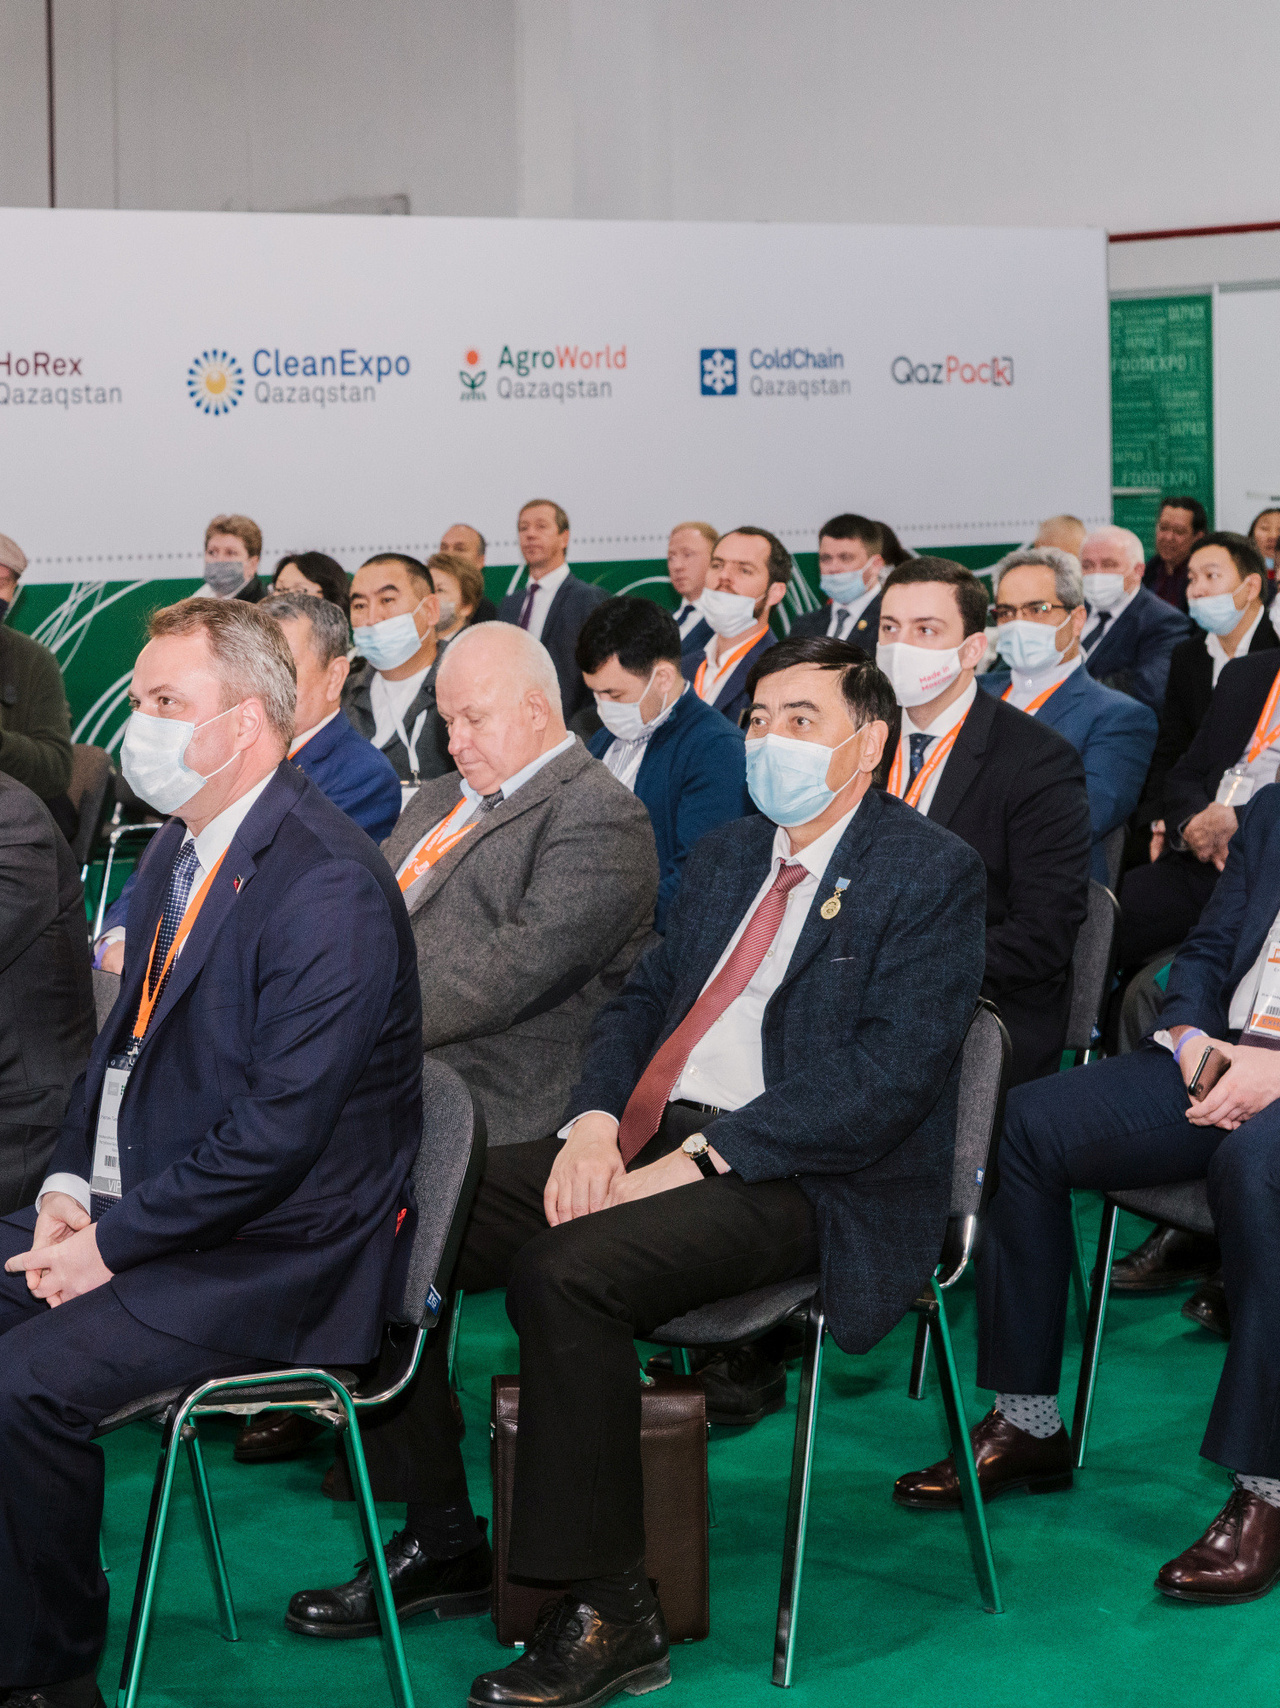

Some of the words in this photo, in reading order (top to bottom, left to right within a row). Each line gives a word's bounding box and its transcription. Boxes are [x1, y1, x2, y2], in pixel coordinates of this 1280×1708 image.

[253, 348, 410, 383] CleanExpo
[498, 344, 627, 377] AgroWorld
[749, 347, 844, 370] ColdChain
[891, 355, 1014, 386] QazPack
[254, 380, 377, 409] Qazaqstan
[497, 376, 613, 405] Qazaqstan
[749, 375, 852, 400] Qazaqstan
[919, 671, 941, 684] Made
[107, 1179, 122, 1192] VIP
